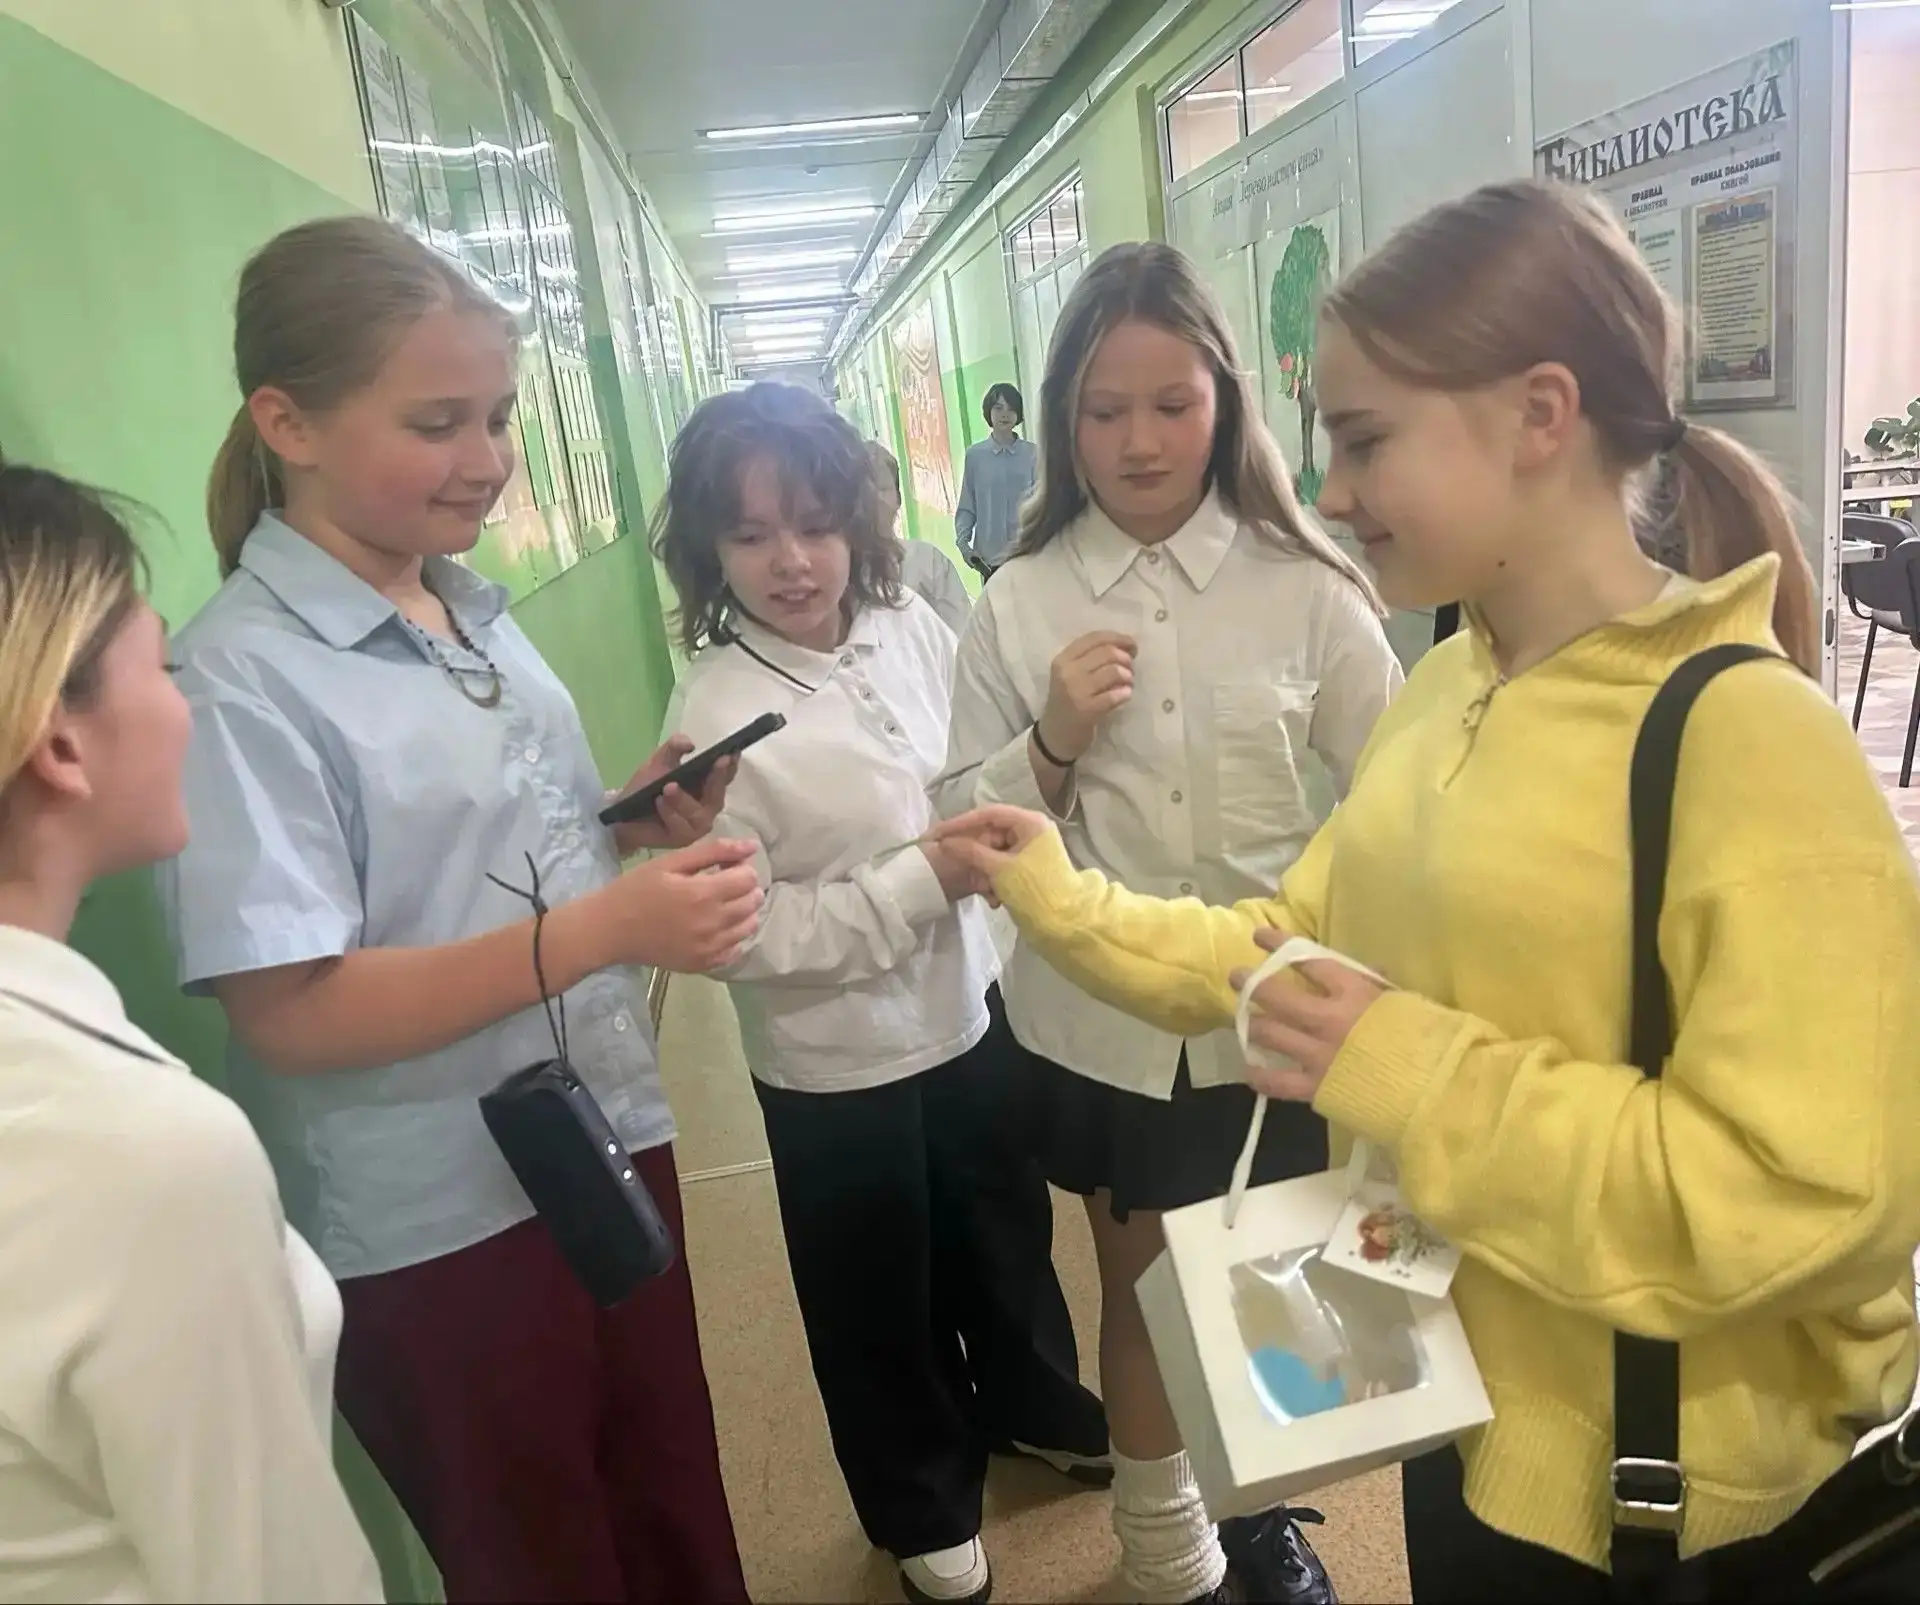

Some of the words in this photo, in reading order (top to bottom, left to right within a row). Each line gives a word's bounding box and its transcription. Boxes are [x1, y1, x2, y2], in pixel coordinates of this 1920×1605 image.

[1541, 74, 1787, 183] БИБЛИОТЕКА
[1690, 168, 1723, 186] ПРАВИЛА
[1631, 184, 1663, 203] ПРАВИЛА
